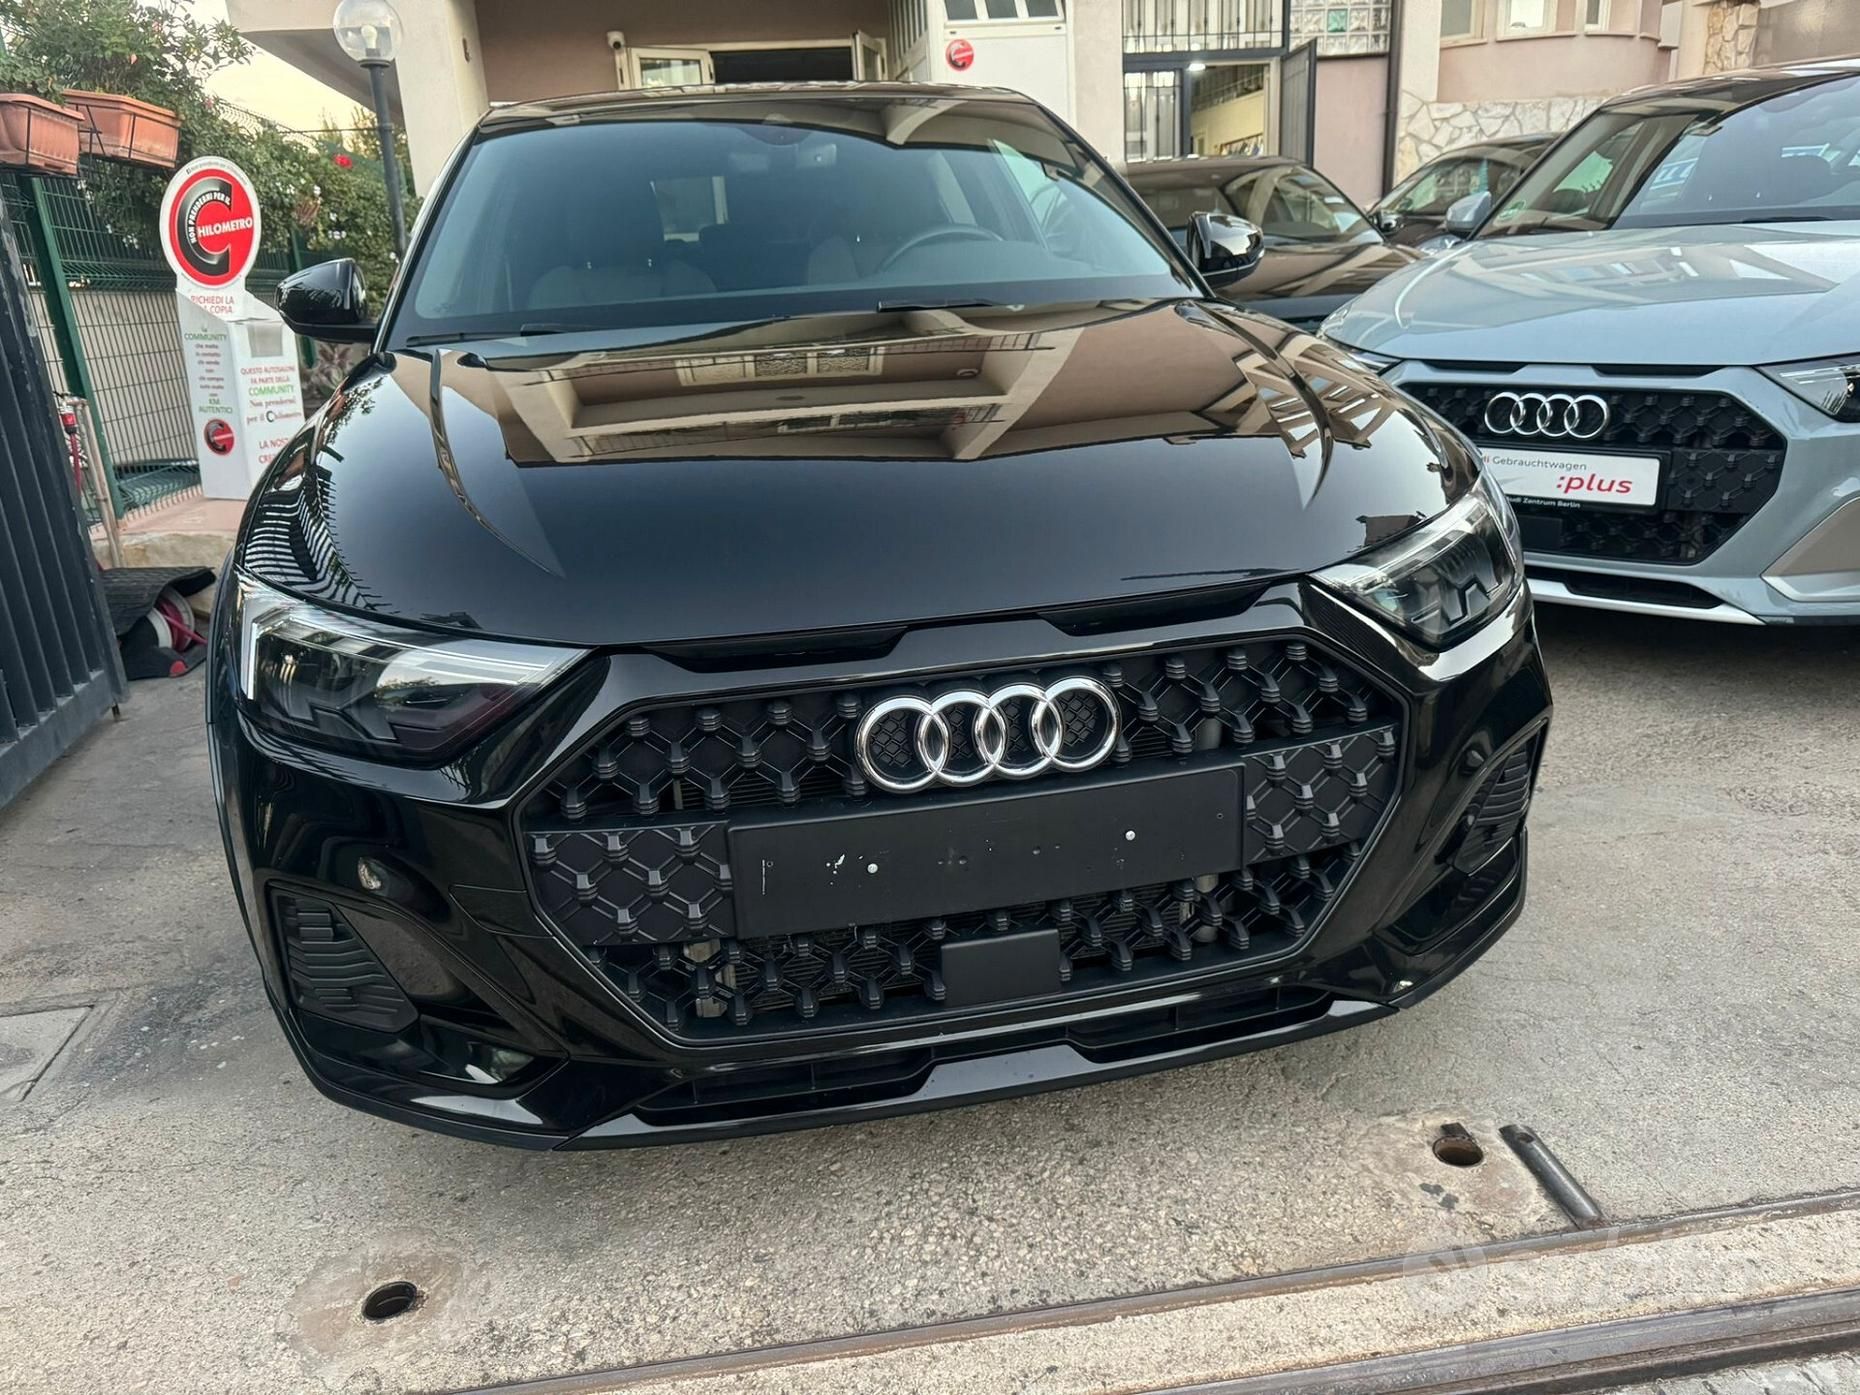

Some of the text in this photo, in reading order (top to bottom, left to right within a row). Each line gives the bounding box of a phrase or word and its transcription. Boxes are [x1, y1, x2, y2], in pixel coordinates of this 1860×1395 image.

[225, 296, 235, 304] LA
[210, 305, 233, 314] COPIA
[184, 333, 227, 341] COMMUNITY
[248, 385, 294, 396] COMMUNITY
[1492, 456, 1587, 471] Gebrauchtwagen
[1523, 498, 1556, 506] Zentrum
